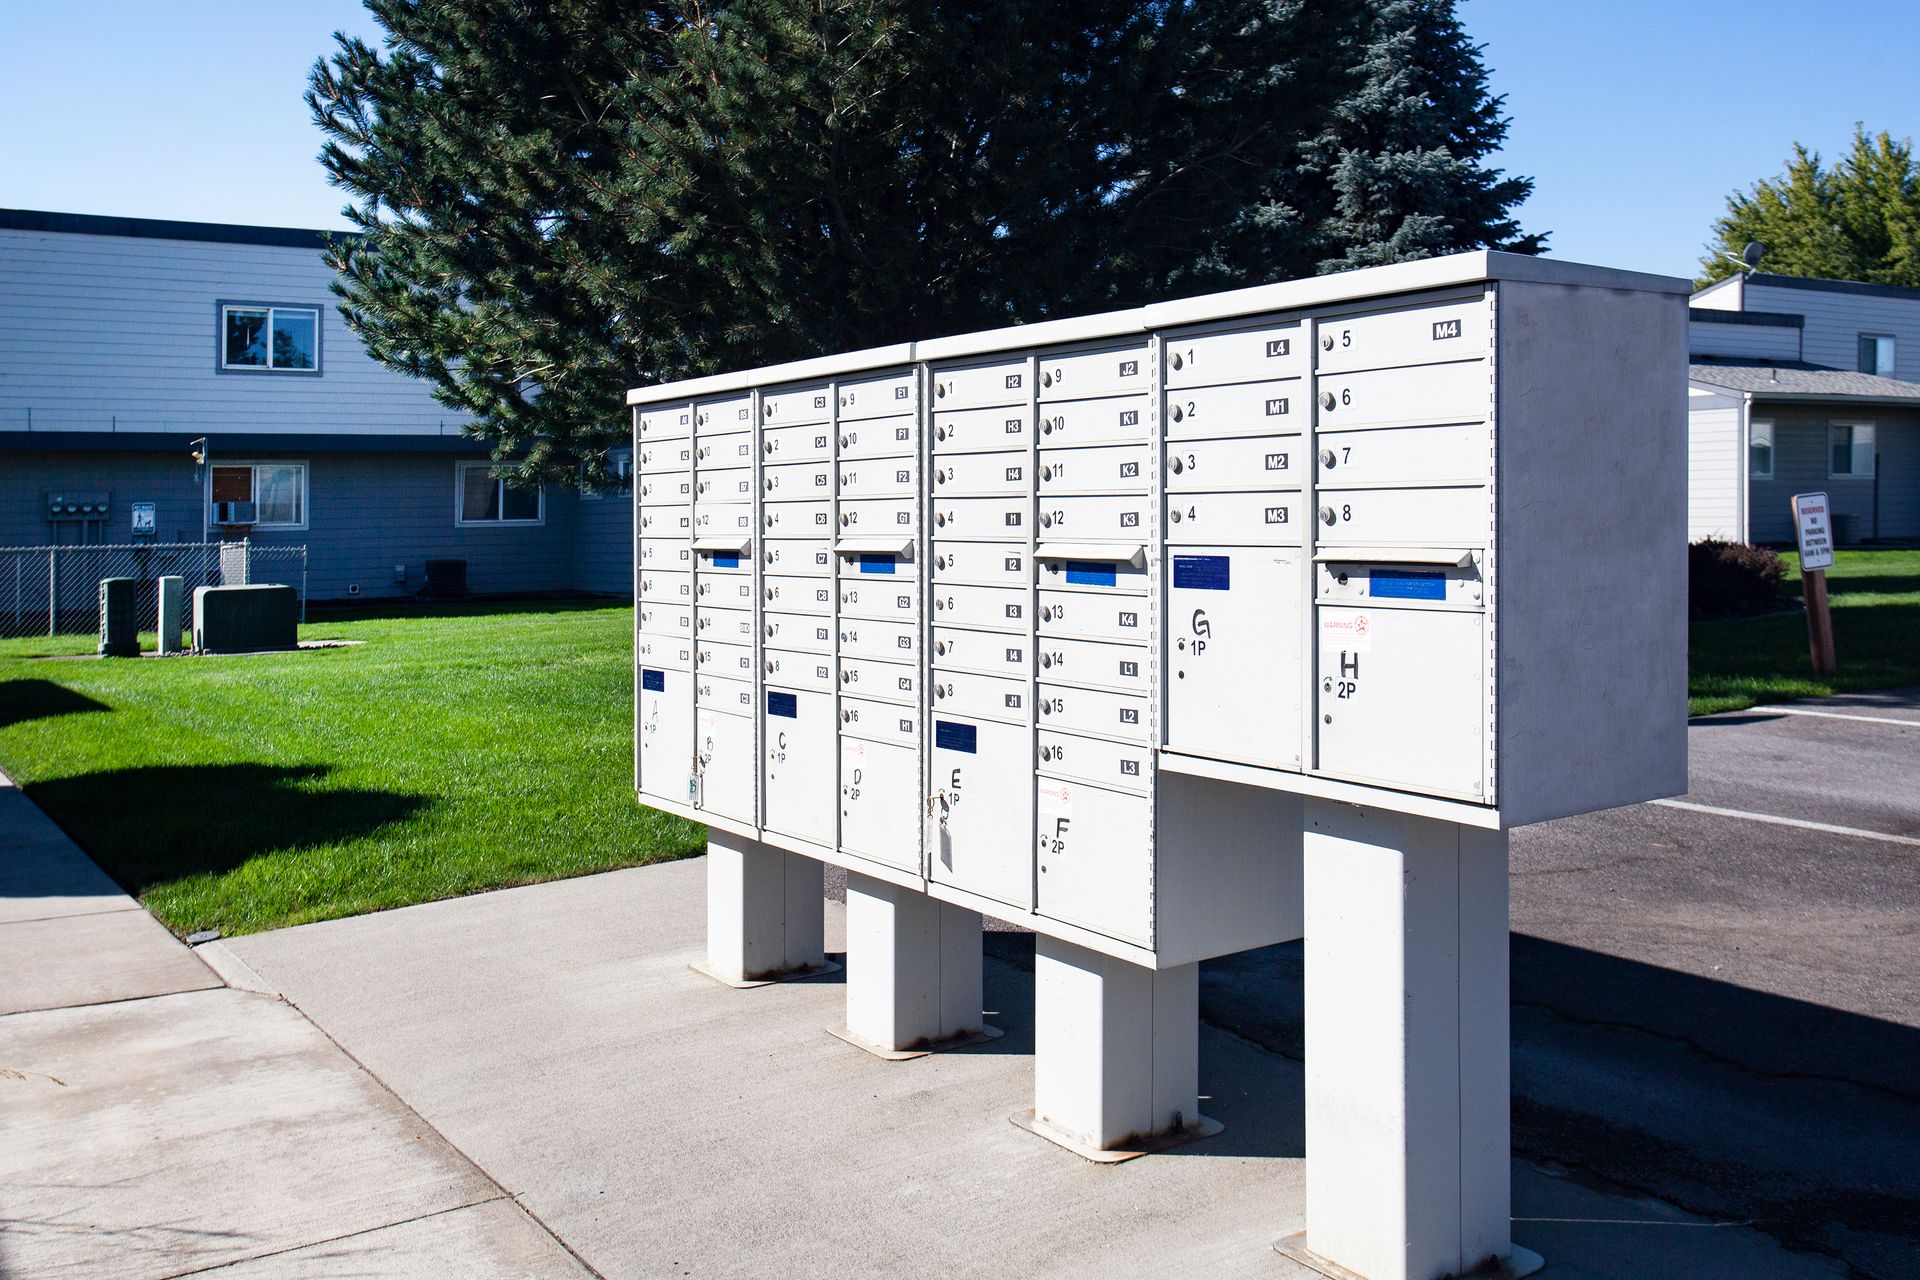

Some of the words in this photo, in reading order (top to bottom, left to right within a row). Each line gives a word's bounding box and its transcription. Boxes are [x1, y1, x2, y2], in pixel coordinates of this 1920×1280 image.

[1436, 322, 1458, 338] M4
[1342, 330, 1351, 348] 5
[1270, 341, 1285, 356] L4
[1188, 348, 1193, 364] 1
[1055, 368, 1062, 383] 9
[1122, 362, 1134, 376] J2
[948, 381, 953, 394] 1
[1008, 376, 1019, 388] H2
[815, 397, 824, 408] C3
[850, 392, 855, 406] 9
[1342, 388, 1351, 406] 6
[774, 402, 778, 413] 1
[1188, 401, 1195, 417] 2
[1270, 400, 1284, 414] M1
[1052, 416, 1064, 430] 10
[1123, 412, 1134, 425] K1
[948, 424, 954, 438] 2
[1008, 420, 1019, 432] H3
[774, 439, 779, 451] 2
[816, 437, 825, 448] C4
[848, 432, 857, 445] 10
[704, 446, 711, 457] 10
[1342, 447, 1351, 464] 7
[1188, 454, 1196, 470] 3
[1268, 455, 1285, 469] M2
[898, 471, 908, 482] F2
[948, 467, 954, 481] 3
[1008, 468, 1020, 480] H4
[1052, 463, 1063, 478] 11
[1122, 464, 1136, 476] K2
[774, 476, 779, 488] 3
[816, 475, 826, 486] C5
[848, 472, 857, 484] 11
[704, 480, 711, 491] 11
[702, 514, 709, 525] 12
[774, 513, 779, 524] 4
[816, 514, 826, 524] C6
[848, 511, 858, 524] 12
[899, 513, 908, 524] G1
[947, 511, 954, 524] 4
[1052, 510, 1064, 525] 12
[1188, 505, 1196, 522] 4
[1267, 508, 1285, 522] M3
[1342, 504, 1351, 522] 8
[1123, 514, 1136, 526] K3
[1805, 527, 1825, 536] PARKING
[1806, 537, 1827, 546] BETWEEN
[774, 550, 780, 562] 5
[817, 554, 826, 564] C7
[948, 554, 954, 567] 5
[1009, 559, 1017, 570] I2
[704, 582, 711, 594] 13
[774, 586, 780, 598] 6
[818, 590, 827, 601] C8
[849, 591, 858, 604] 13
[898, 597, 909, 608] G2
[948, 596, 954, 610] 6
[1009, 606, 1018, 617] I3
[1052, 604, 1064, 620] 13
[704, 617, 711, 627] 14
[1121, 613, 1134, 626] K4
[1192, 608, 1211, 639] G
[1324, 621, 1353, 630] WARNING
[775, 623, 780, 635] 7
[818, 629, 826, 639] D1
[849, 630, 858, 643] 14
[899, 637, 910, 648] G3
[948, 640, 954, 654] 7
[1191, 640, 1206, 656] 1P
[704, 651, 711, 662] 15
[1010, 650, 1018, 661] I4
[1052, 652, 1064, 666] 14
[775, 660, 780, 672] 8
[1124, 663, 1133, 675] L1
[1340, 650, 1359, 680] H
[818, 667, 827, 678] D2
[849, 670, 858, 682] 15
[704, 685, 711, 696] 16
[900, 678, 910, 690] G4
[947, 683, 954, 697] 8
[1338, 681, 1356, 699] 2P
[1008, 696, 1018, 707] J1
[1052, 698, 1064, 713] 15
[850, 709, 859, 722] 16
[1123, 710, 1135, 723] L2
[778, 732, 786, 750] C
[777, 752, 786, 763] 1P
[1051, 745, 1063, 760] 16
[1124, 761, 1136, 774] L3
[854, 768, 862, 785] D
[951, 768, 962, 789] E
[850, 788, 860, 800] 2P
[948, 792, 960, 806] 1P
[1056, 818, 1070, 839] F
[1052, 839, 1064, 854] 2P
